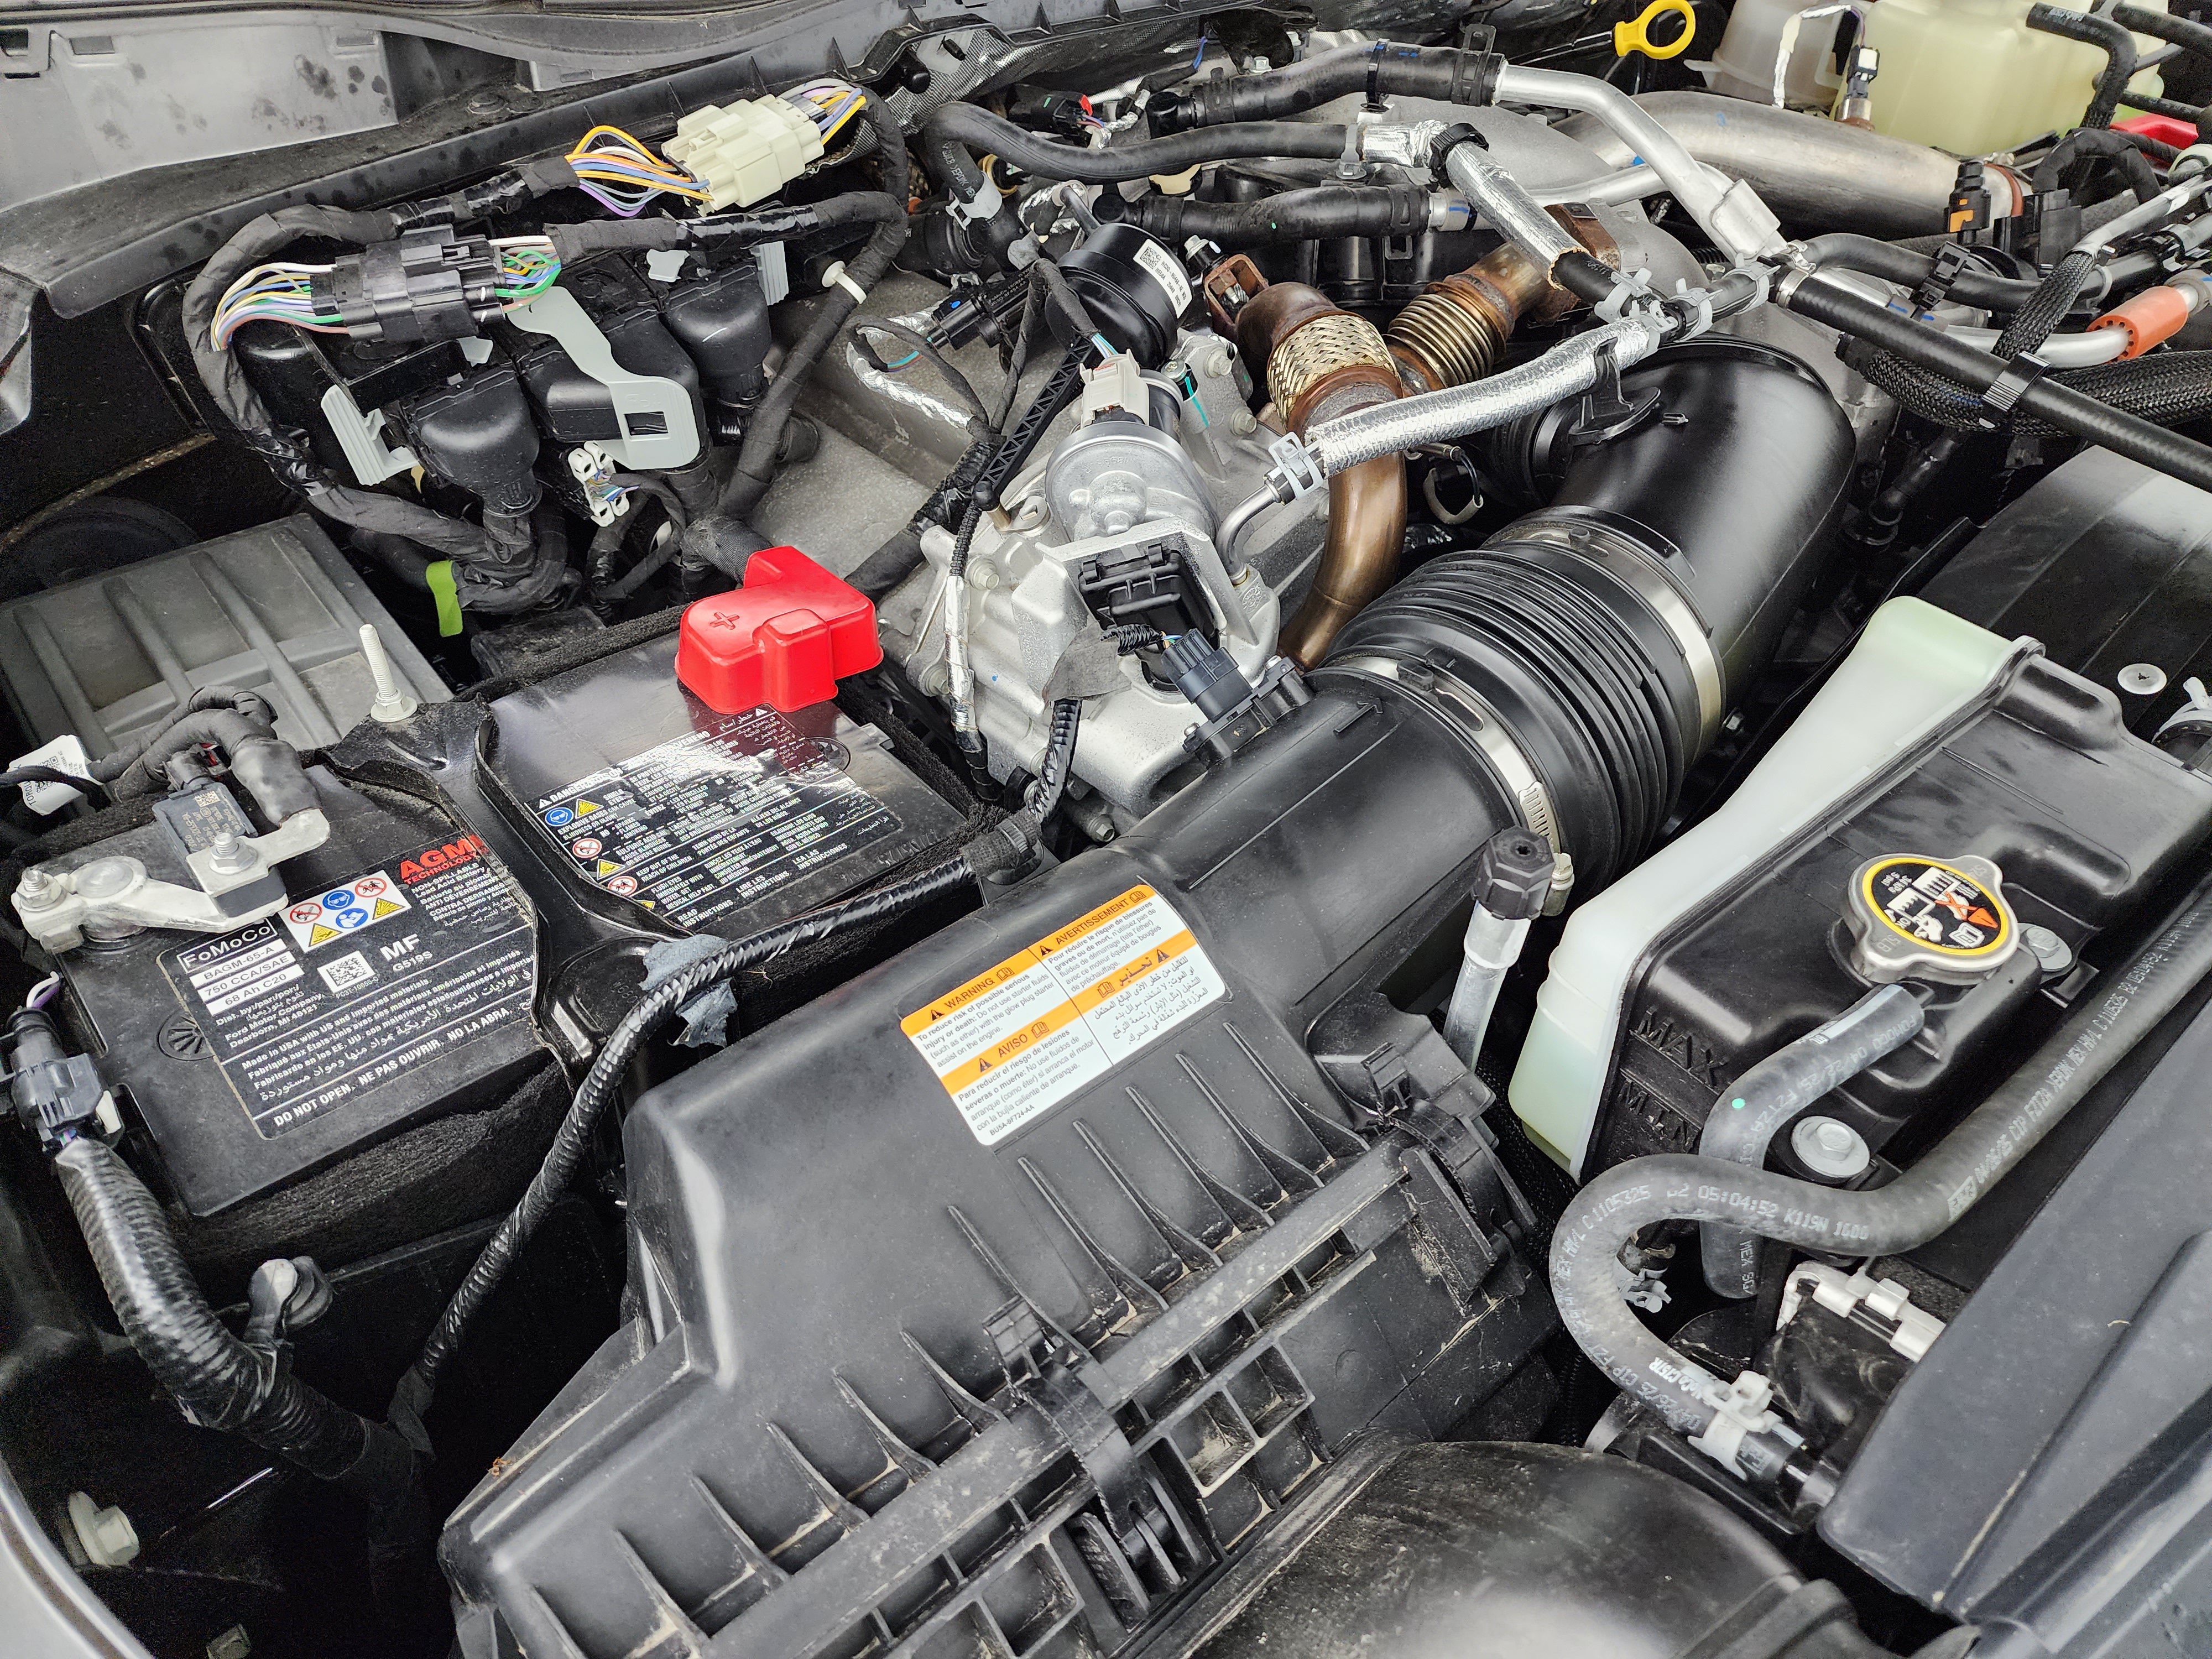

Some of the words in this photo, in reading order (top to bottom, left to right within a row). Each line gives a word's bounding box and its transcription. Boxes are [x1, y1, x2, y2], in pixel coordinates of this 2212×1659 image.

[400, 839, 476, 875] AGM
[404, 851, 478, 885] TECHNOLOGY
[792, 855, 806, 864] LEA
[805, 849, 819, 858] LAS
[411, 863, 478, 893] NON-SPILLABLE
[735, 881, 753, 893] LIRE
[751, 875, 765, 885] LES
[430, 900, 462, 916] CONTRA
[463, 883, 504, 902] DERRAMES
[677, 909, 697, 922] READ
[1047, 952, 1064, 963] Pour
[1095, 924, 1114, 936] risque
[1122, 901, 1152, 920] blessures
[1056, 899, 1128, 944] AVERTISSEMENT
[184, 923, 271, 967] FoMoCo
[204, 947, 274, 979] BAGM-65-A
[380, 933, 422, 961] MF
[393, 951, 433, 972] G519S
[1055, 956, 1076, 971] graves
[1136, 914, 1147, 923] pas
[1059, 963, 1080, 977] fluides
[1089, 940, 1120, 959] démarrage
[1120, 932, 1133, 942] (tels
[1066, 973, 1081, 984] avec
[1089, 955, 1109, 970] moteur
[1137, 925, 1161, 941] bougies
[205, 983, 227, 995] 750
[231, 956, 288, 984] CCA/SAE
[225, 994, 239, 1005] 68
[244, 987, 260, 997] Ah
[263, 974, 286, 987] C20
[944, 978, 994, 1008] WARNING
[277, 1016, 290, 1026] MI
[291, 1004, 317, 1019] 48121
[923, 1035, 945, 1050] injury
[955, 1016, 977, 1031] death:
[987, 1003, 999, 1012] not
[998, 996, 1011, 1005] use
[1011, 984, 1031, 998] starter
[1031, 974, 1048, 985] fluids
[928, 1020, 952, 1035] reduce
[953, 1011, 967, 1021] risk
[975, 989, 1004, 1008] possible
[1005, 974, 1029, 990] serious
[930, 1045, 950, 1059] (such
[959, 1026, 979, 1041] ether)
[979, 1019, 993, 1029] with
[992, 1012, 1004, 1020] the
[1004, 1003, 1019, 1015] glow
[1020, 994, 1035, 1006] plug
[1034, 982, 1053, 996] starter
[225, 1026, 248, 1041] Ford
[248, 1014, 276, 1030] Motor
[242, 1054, 268, 1069] Made
[279, 1039, 300, 1051] USA
[319, 1022, 333, 1032] US
[334, 1014, 350, 1026] and
[937, 1052, 957, 1067] assist
[966, 1040, 978, 1049] the
[978, 1026, 1002, 1042] engine.
[998, 1034, 1027, 1057] AVISO
[1636, 1006, 1729, 1086] MAX
[274, 1112, 292, 1126] DO
[293, 1099, 317, 1117] NOT
[358, 1071, 375, 1085] NE
[374, 1060, 398, 1077] PAS
[447, 1028, 464, 1041] NO
[463, 1021, 480, 1033] LA
[958, 1088, 975, 1101] Para
[976, 1072, 1000, 1090] reducir
[1003, 1066, 1009, 1074] el
[1010, 1053, 1031, 1070] riesgo
[1041, 1030, 1070, 1049] lesiones
[965, 1091, 993, 1110] severas
[1000, 1070, 1026, 1089] muerte:
[1025, 1063, 1036, 1072] No
[1037, 1055, 1049, 1065] use
[1048, 1042, 1070, 1057] fluidos
[971, 1099, 1000, 1120] arranque
[1000, 1086, 1021, 1102] (como
[1037, 1070, 1045, 1078] si
[1045, 1056, 1069, 1073] arranca
[1069, 1050, 1076, 1058] el
[1076, 1039, 1093, 1053] motor
[977, 1119, 990, 1130] con
[1015, 1087, 1040, 1106] caliente
[1618, 1079, 1690, 1146] MIN
[1697, 1185, 1781, 1219] 05:04:52
